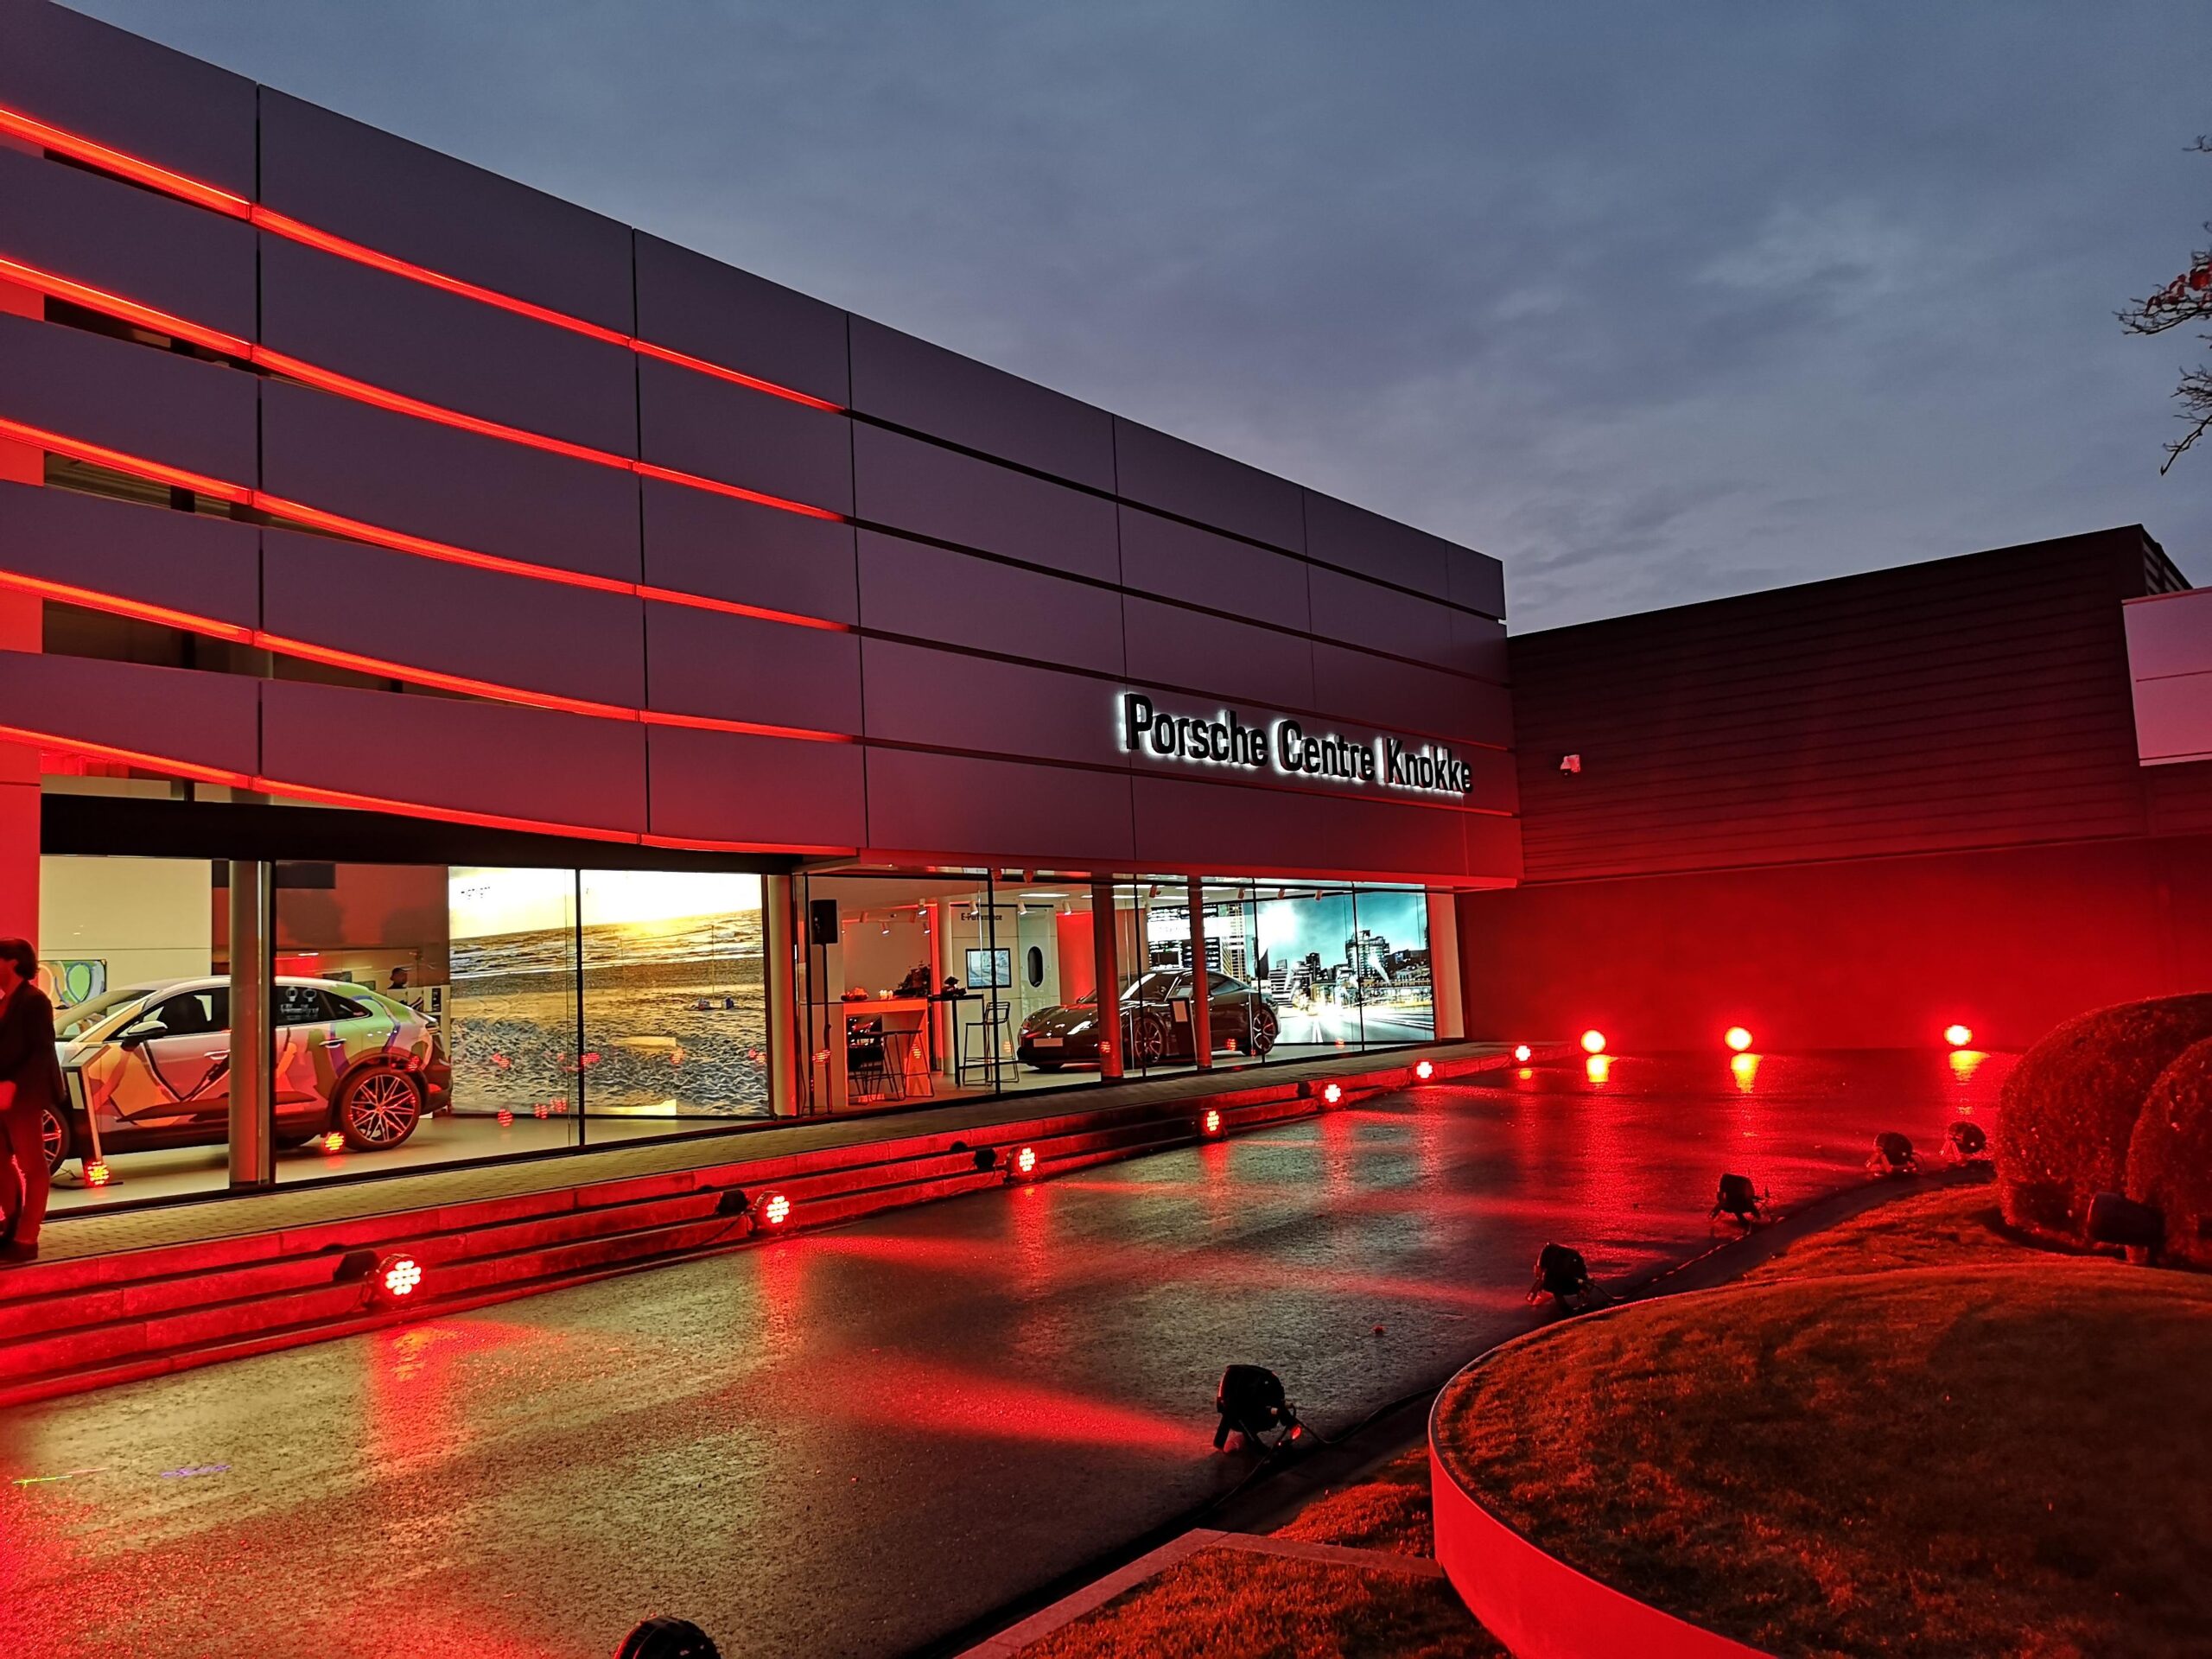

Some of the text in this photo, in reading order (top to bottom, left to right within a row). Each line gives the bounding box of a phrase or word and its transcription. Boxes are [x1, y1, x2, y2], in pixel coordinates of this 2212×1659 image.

[1123, 692, 1473, 794] Porsche Centre Knokke
